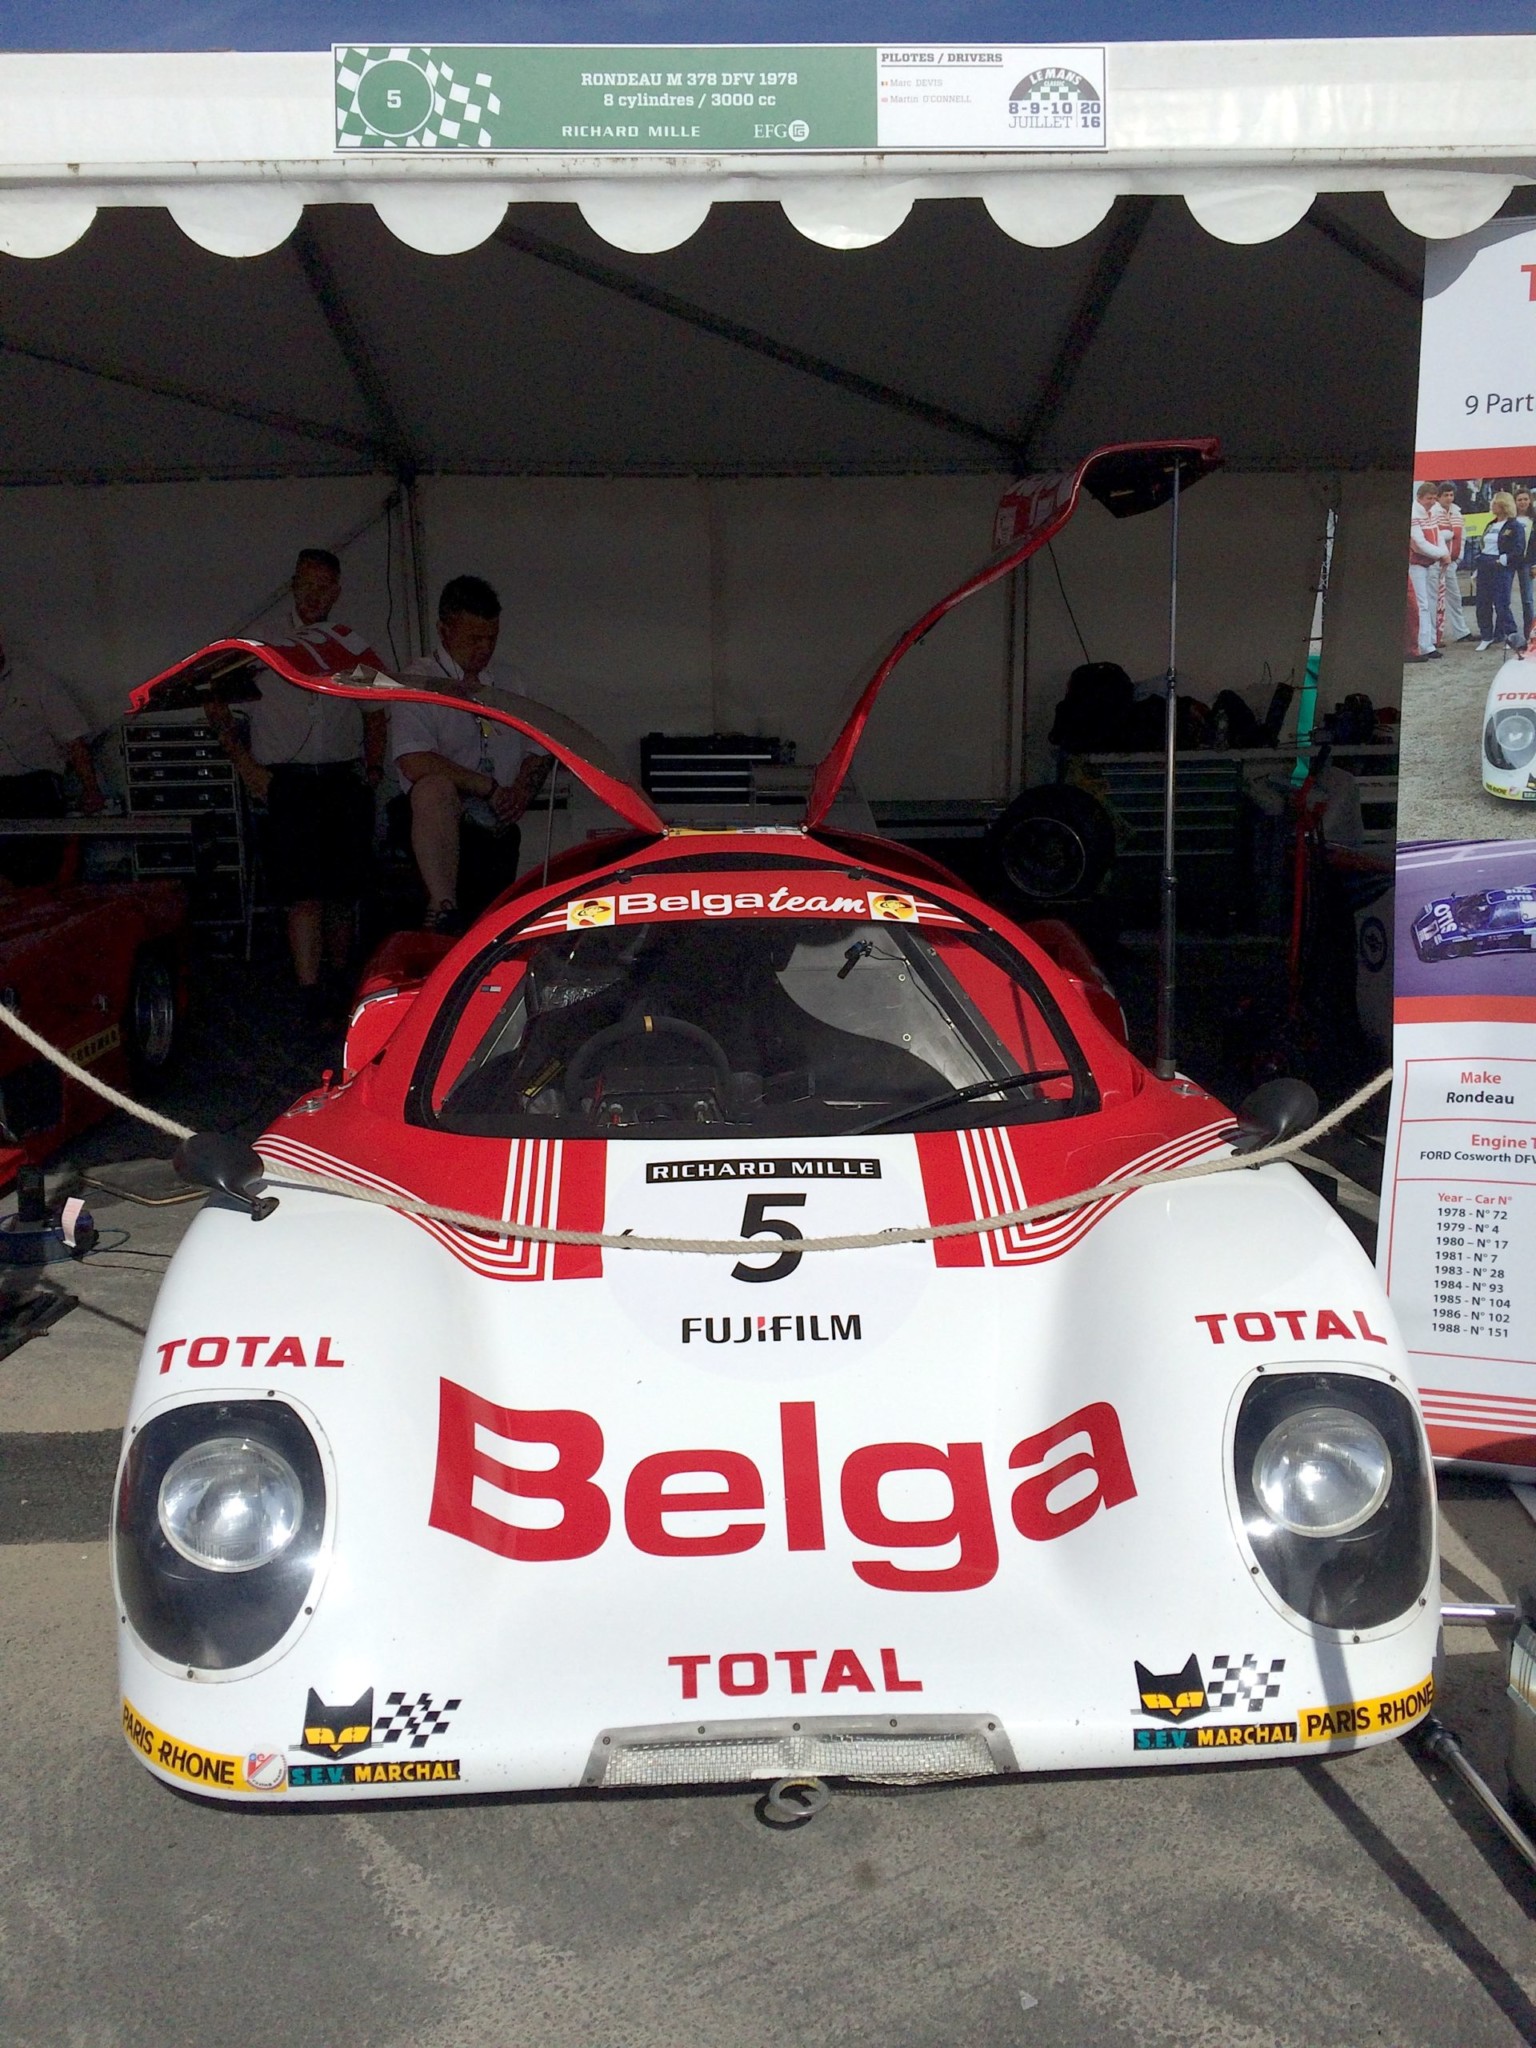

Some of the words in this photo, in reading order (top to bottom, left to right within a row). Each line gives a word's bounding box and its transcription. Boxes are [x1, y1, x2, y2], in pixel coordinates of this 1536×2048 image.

[881, 53, 935, 63] PILOTES
[947, 53, 1003, 63] DRIVERS
[581, 73, 662, 86] RONDEAU
[666, 73, 682, 86] M
[687, 73, 717, 85] 378
[721, 73, 754, 85] DFV
[759, 73, 798, 85] 1978
[890, 79, 912, 87] Marc
[915, 79, 943, 87] DEVIS
[1044, 68, 1082, 85] MANS
[387, 89, 402, 109] 5
[603, 93, 614, 106] 8
[618, 93, 694, 108] cylindres
[697, 94, 706, 108] /
[711, 93, 753, 106] 3000
[758, 96, 776, 105] cc
[890, 95, 919, 103] Martin
[1080, 102, 1101, 114] 20
[1008, 116, 1073, 128] JUILLET
[1081, 116, 1101, 128] 16
[562, 126, 638, 137] RICHARD
[648, 125, 700, 137] MILLE
[754, 123, 787, 138] EFG
[1465, 395, 1479, 415] 9
[618, 893, 764, 916] Belga
[767, 886, 866, 914] team
[1460, 1071, 1502, 1084] Make
[1446, 1091, 1515, 1104] Rondeau
[1472, 1134, 1527, 1150] Engine
[1420, 1151, 1452, 1160] FORD
[1454, 1151, 1511, 1162] Cosworth
[652, 1162, 776, 1180] RICHARD
[791, 1161, 875, 1176] MILLE
[1438, 1193, 1463, 1202] Year
[1475, 1195, 1495, 1204] Car
[1438, 1208, 1466, 1217] 1978
[1493, 1211, 1507, 1220] 72
[1437, 1222, 1465, 1232] 1979
[1492, 1225, 1499, 1234] 4
[730, 1193, 807, 1283] 5
[1437, 1237, 1464, 1246] 1980
[1495, 1240, 1508, 1249] 17
[1436, 1251, 1462, 1260] 1981
[1491, 1255, 1498, 1263] 7
[1435, 1266, 1463, 1275] 1983
[1490, 1269, 1505, 1279] 28
[1434, 1280, 1462, 1290] 1984
[1489, 1284, 1504, 1293] 93
[1434, 1294, 1462, 1304] 1985
[1490, 1298, 1511, 1308] 104
[1433, 1309, 1461, 1319] 1986
[1489, 1313, 1510, 1323] 102
[682, 1315, 862, 1344] FUJIFILM
[1195, 1309, 1388, 1345] TOTAL
[1432, 1323, 1460, 1333] 1988
[1488, 1328, 1508, 1338] 151
[157, 1336, 345, 1375] TOTAL
[429, 1377, 1138, 1592] Belga
[668, 1647, 923, 1699] TOTAL
[1307, 1706, 1371, 1737] PARIS
[1377, 1681, 1433, 1726] RHONE
[1197, 1726, 1294, 1746] MARCHAL
[122, 1705, 154, 1756] PARIS
[158, 1740, 235, 1785] RHONE
[354, 1762, 457, 1782] MARCHAL
